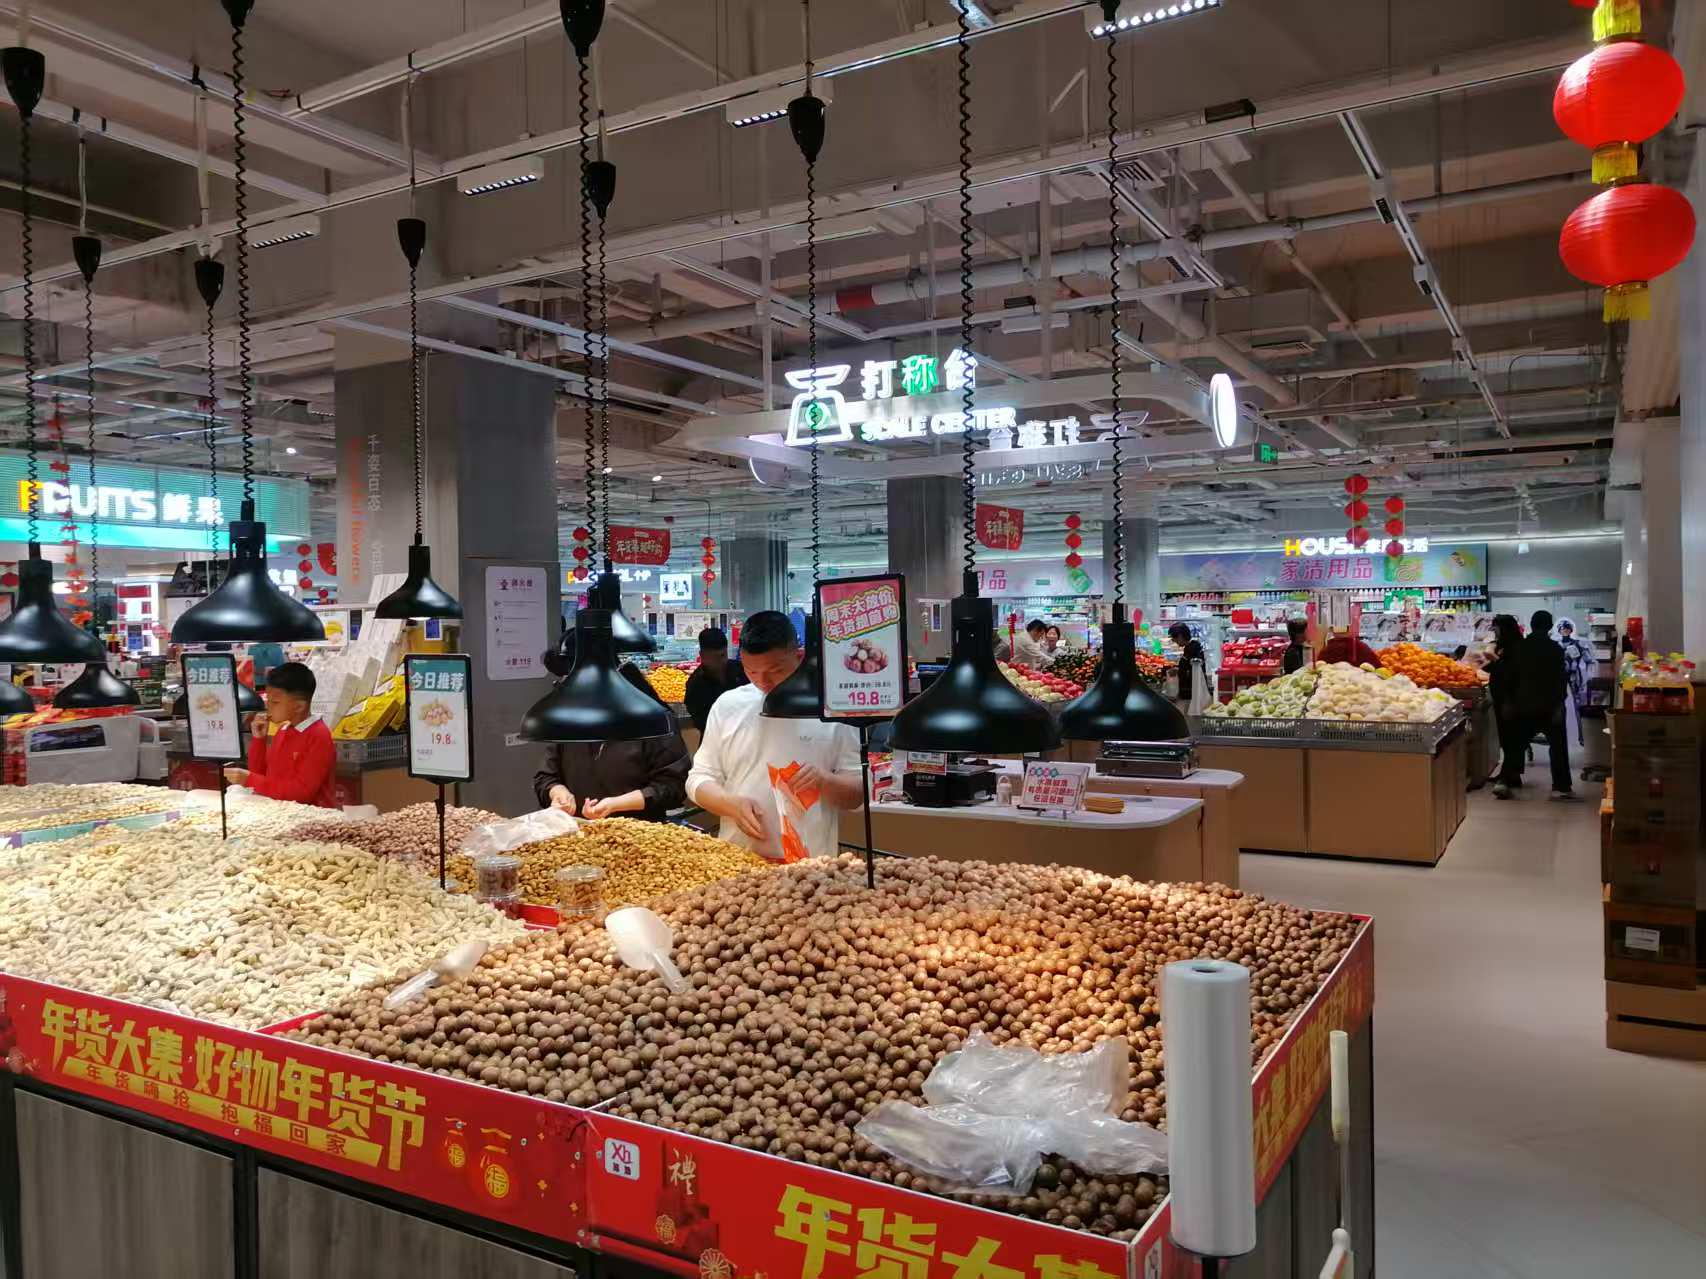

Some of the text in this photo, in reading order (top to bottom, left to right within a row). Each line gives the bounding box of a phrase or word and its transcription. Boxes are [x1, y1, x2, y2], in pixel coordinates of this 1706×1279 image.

[18, 479, 157, 521] FRUITS
[1283, 536, 1362, 557] HOUS
[1280, 558, 1373, 582] 家清用品
[410, 671, 465, 691] 今日推荐
[848, 691, 880, 706] 19.8
[41, 999, 427, 1172] 年货大集 好物年货节
[485, 1164, 510, 1198] 福
[773, 1183, 1118, 1279] 年货
